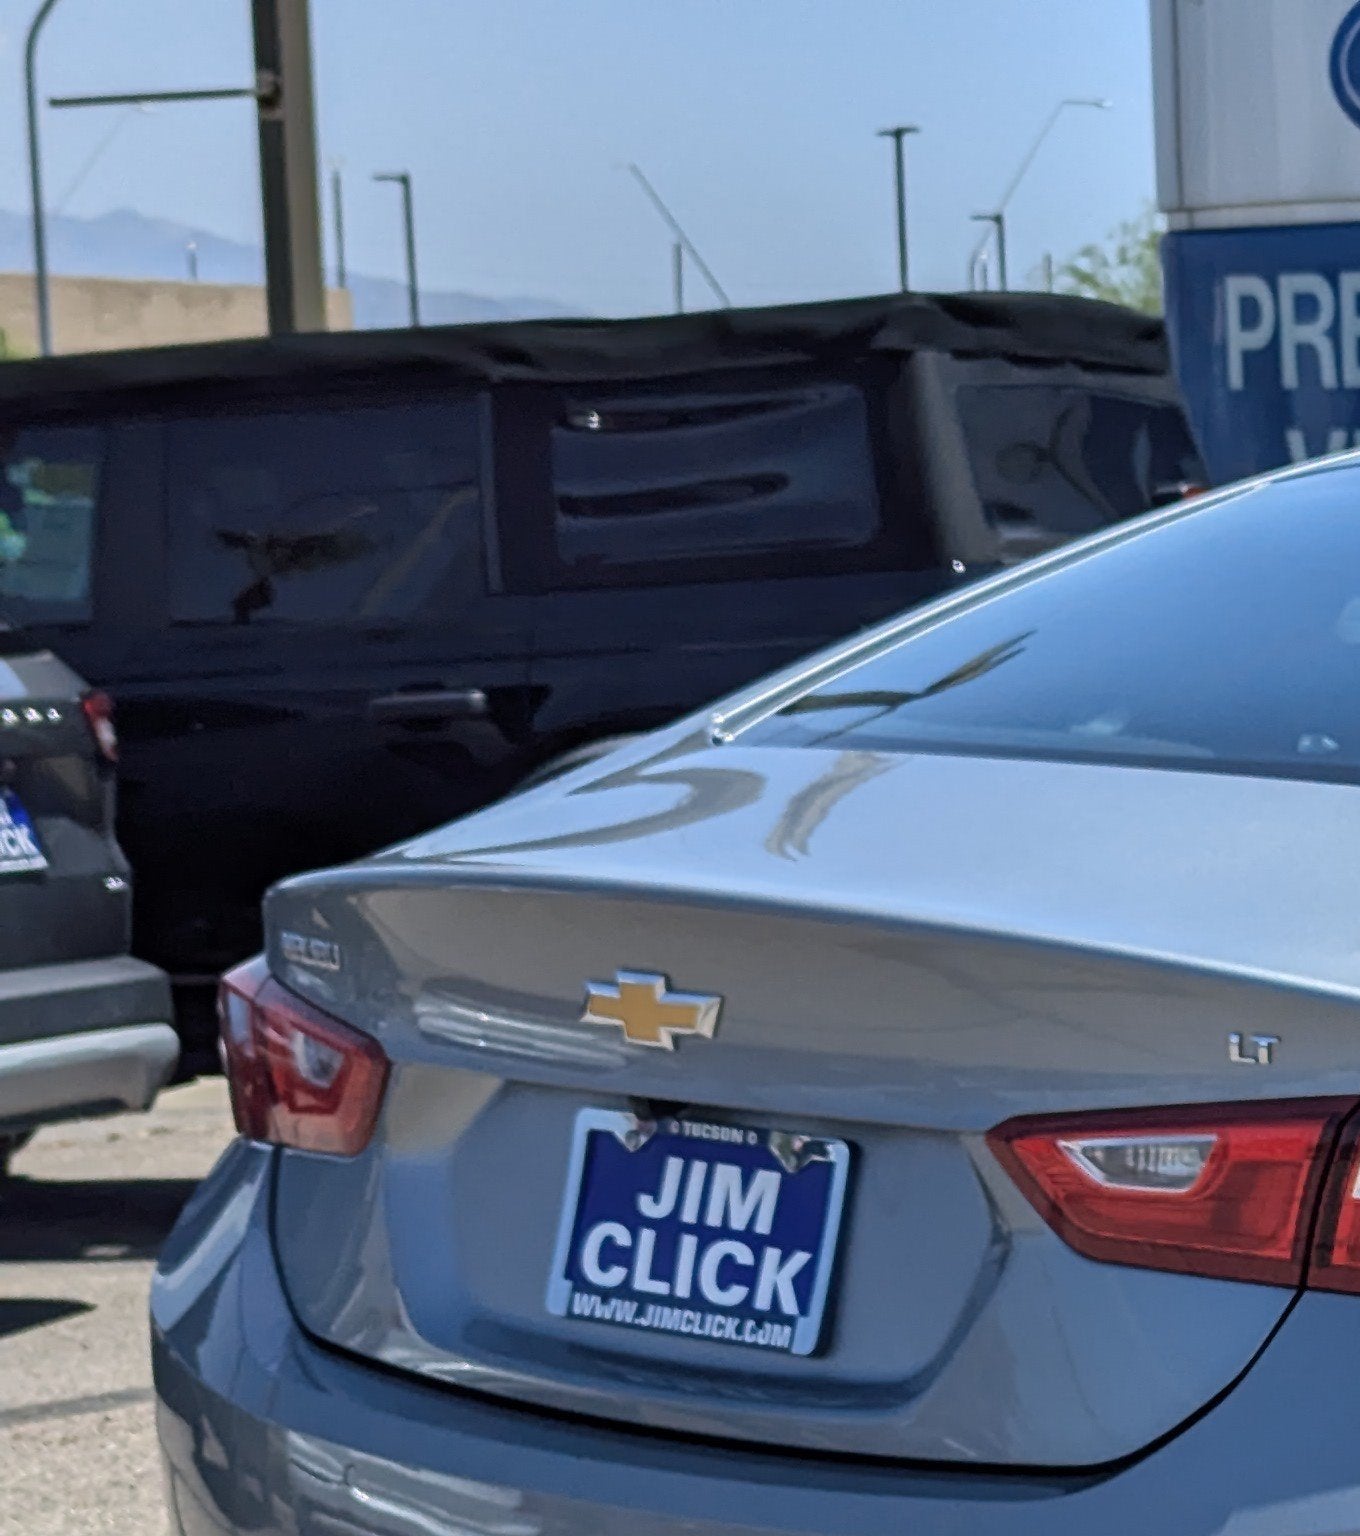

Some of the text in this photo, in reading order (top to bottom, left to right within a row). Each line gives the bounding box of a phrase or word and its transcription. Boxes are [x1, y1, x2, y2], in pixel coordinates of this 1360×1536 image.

[1227, 1031, 1281, 1065] LT
[682, 1119, 745, 1145] TUCSON
[637, 1155, 782, 1236] JIM
[580, 1220, 813, 1316] CLICK
[572, 1291, 793, 1349] WWW.JIMCLICK.COM
